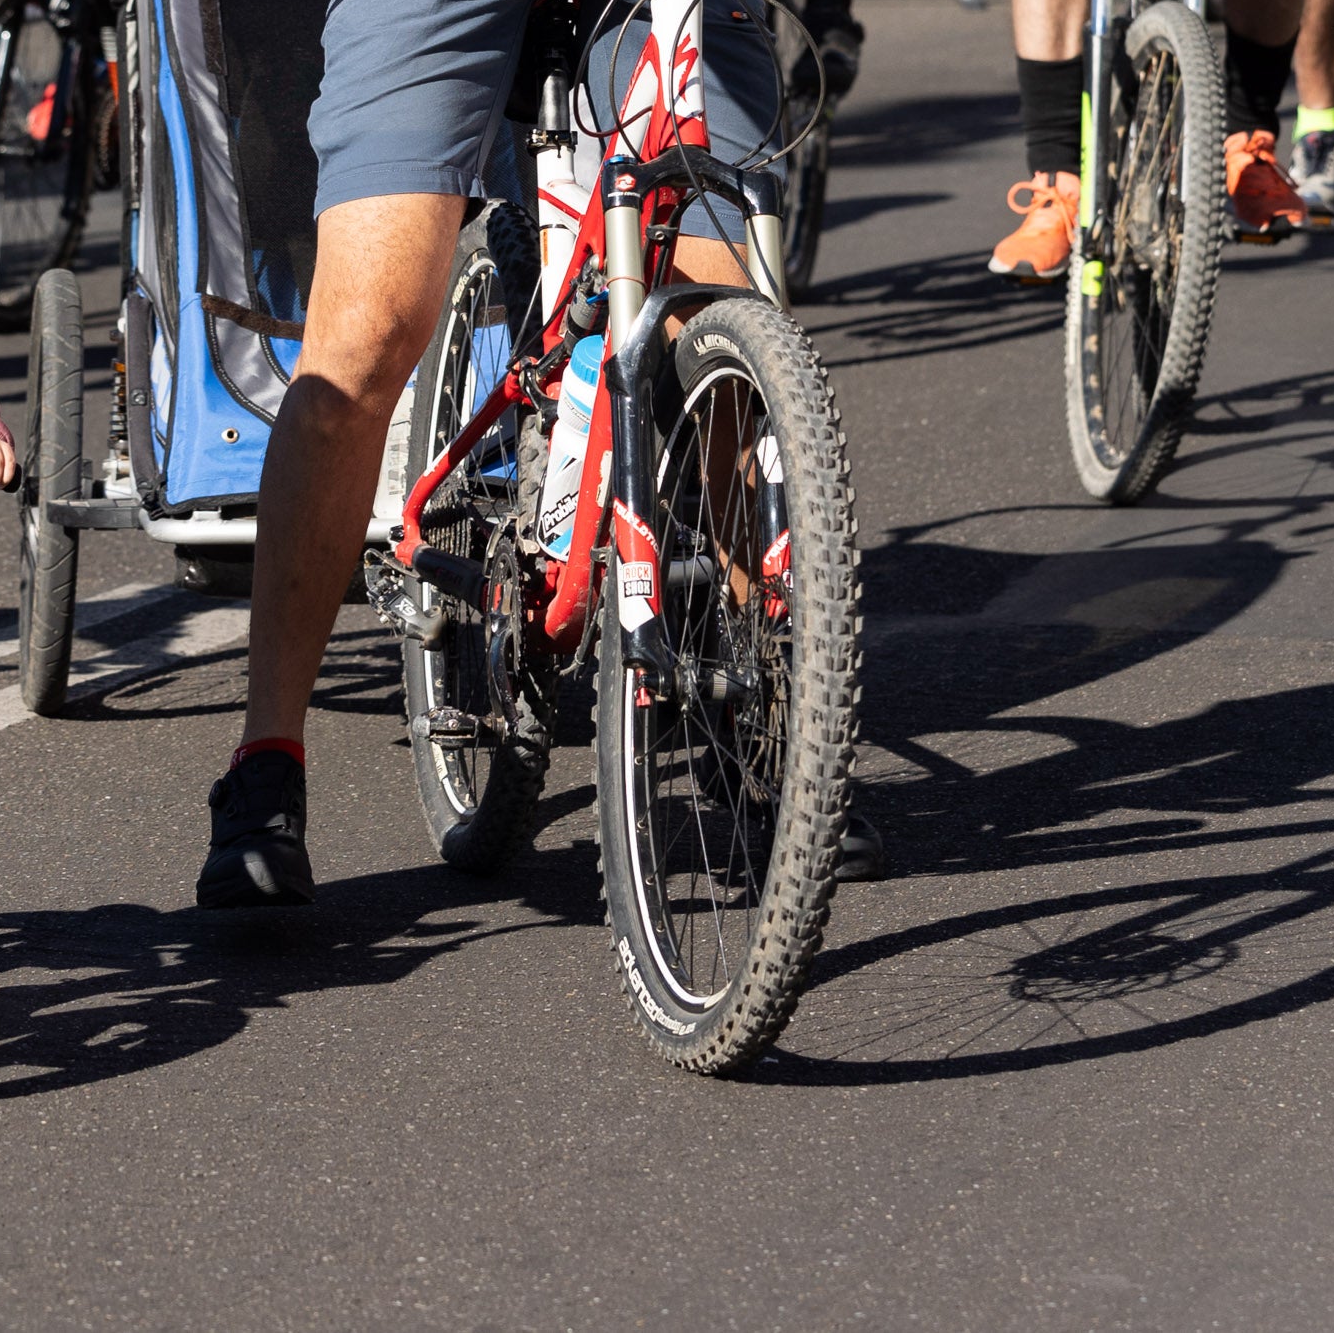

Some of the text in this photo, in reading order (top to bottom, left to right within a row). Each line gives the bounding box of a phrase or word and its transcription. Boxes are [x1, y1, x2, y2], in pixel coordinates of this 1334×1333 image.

[704, 334, 740, 358] MICHELIN
[625, 566, 650, 579] ROCK
[625, 581, 652, 596] SHOX
